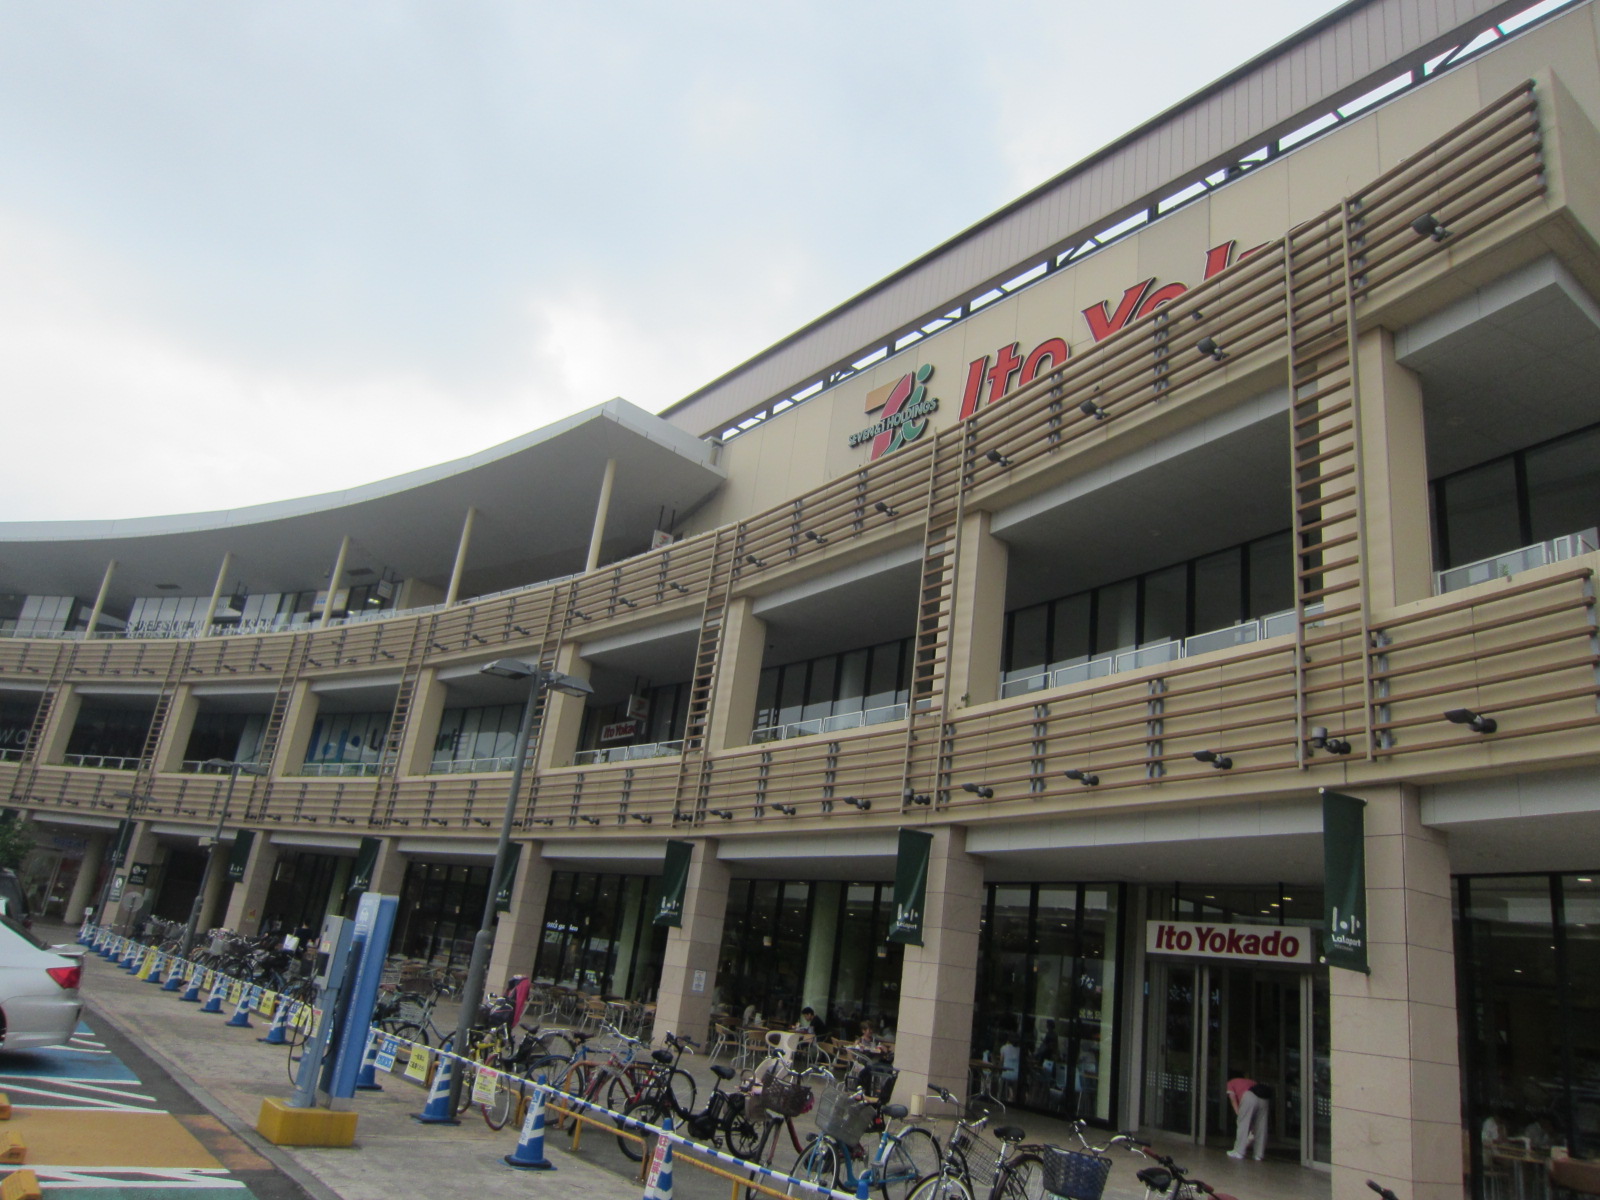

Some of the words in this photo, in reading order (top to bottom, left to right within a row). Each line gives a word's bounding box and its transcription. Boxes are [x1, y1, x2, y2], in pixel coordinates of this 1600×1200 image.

[959, 338, 1069, 422] Ito
[886, 397, 938, 429] HOLDINGS
[1155, 924, 1193, 951] Ito
[1194, 926, 1300, 958] Yokado
[647, 1135, 669, 1189] 駐輪禁止
